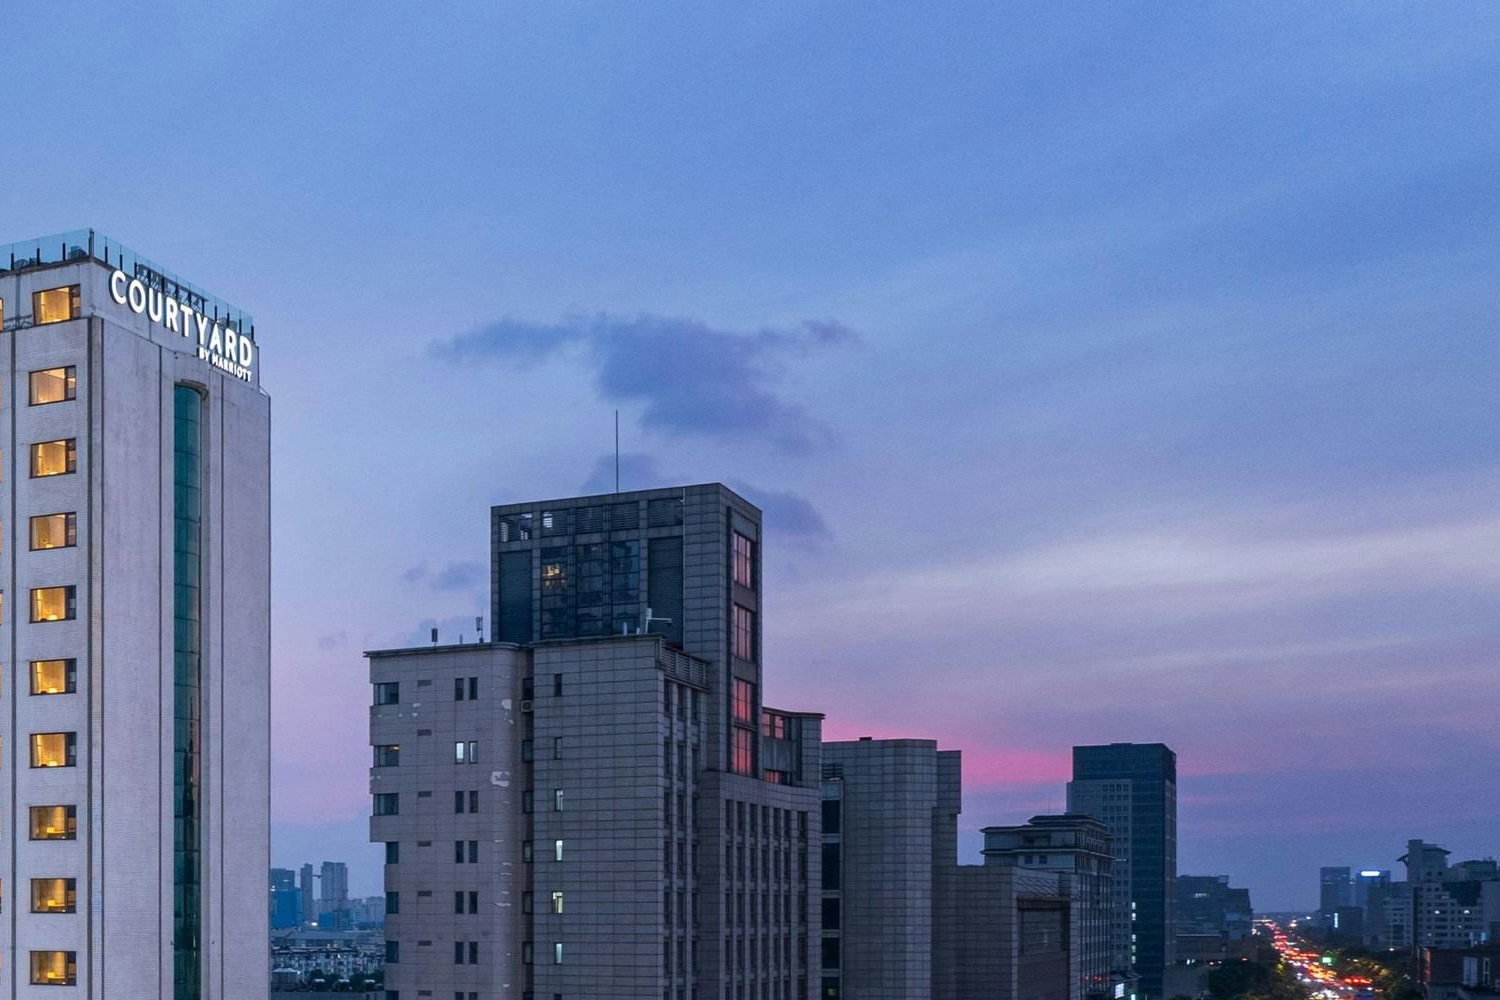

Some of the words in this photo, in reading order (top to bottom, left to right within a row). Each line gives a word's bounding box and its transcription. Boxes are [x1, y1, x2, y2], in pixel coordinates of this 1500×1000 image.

[111, 270, 252, 367] COURTYARD
[199, 347, 211, 361] BY
[211, 353, 252, 382] MARRIOTT
